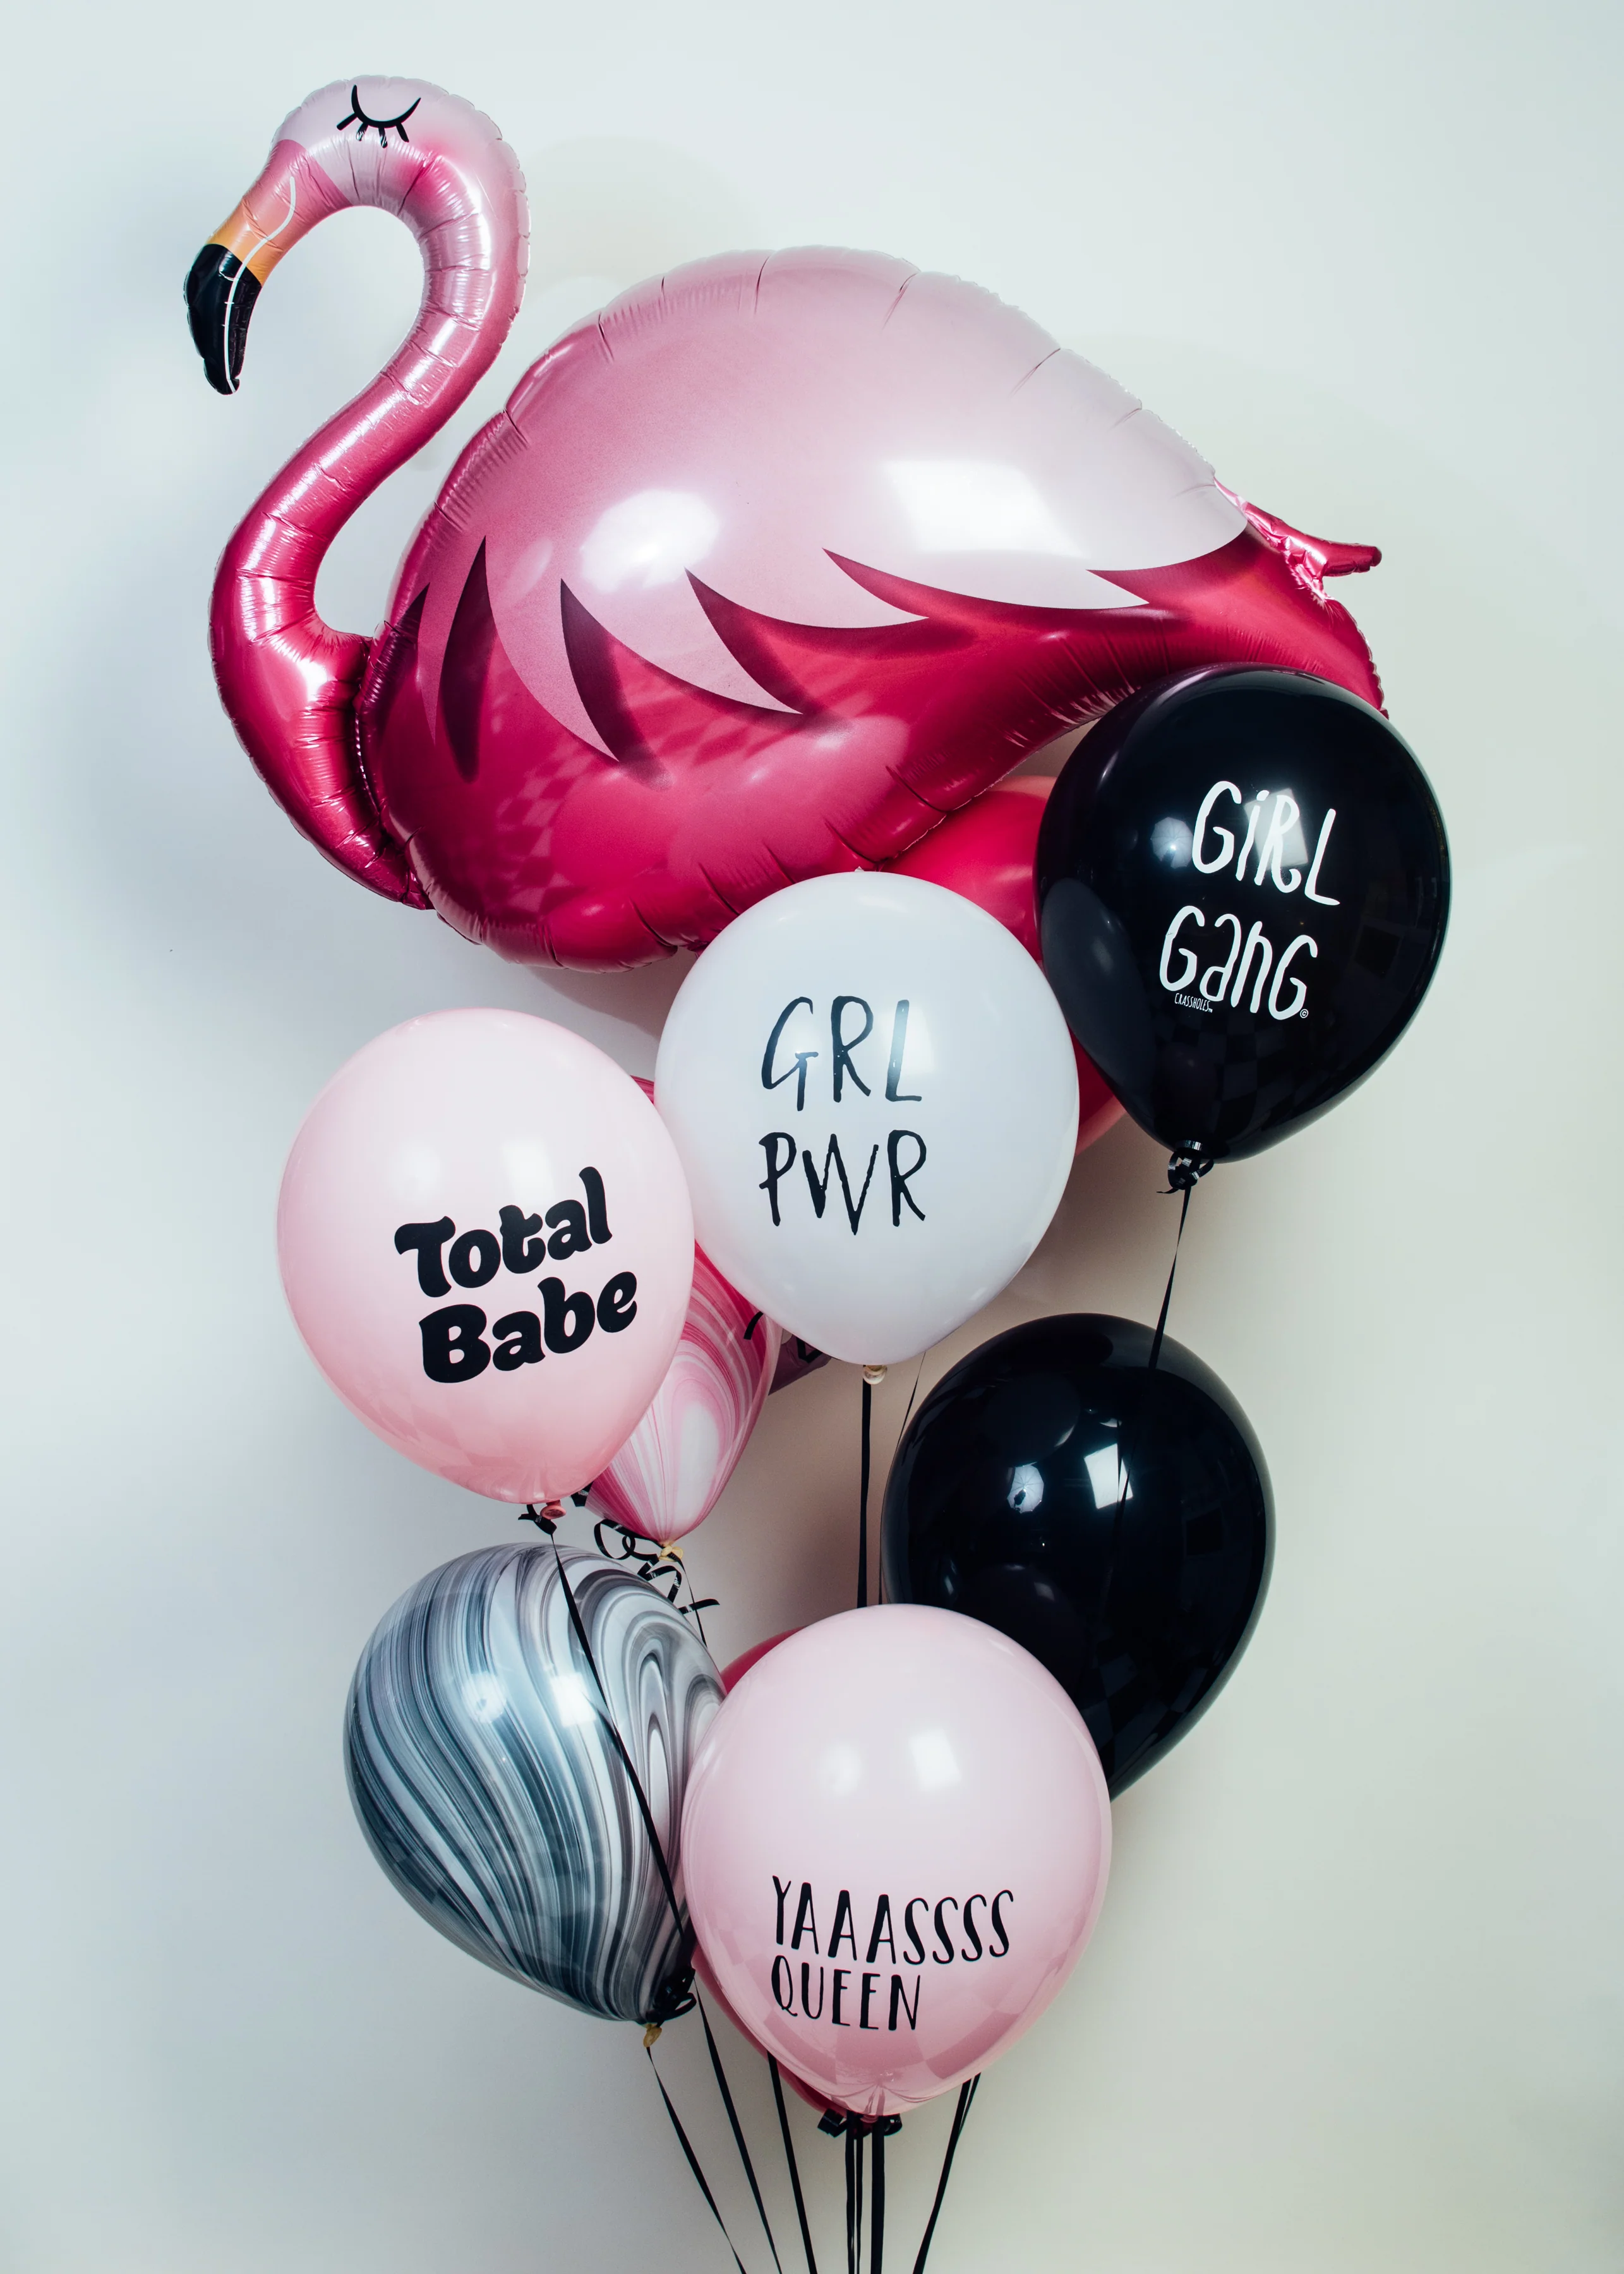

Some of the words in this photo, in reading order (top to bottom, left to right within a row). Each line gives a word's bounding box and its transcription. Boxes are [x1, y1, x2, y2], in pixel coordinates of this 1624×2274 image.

[761, 996, 922, 1111] GRL
[394, 1166, 613, 1297] Total
[759, 1129, 927, 1236] PWR
[419, 1271, 637, 1383] Babe
[773, 1875, 1014, 1965] YAAASSSS
[771, 1955, 920, 2031] QUEEN
